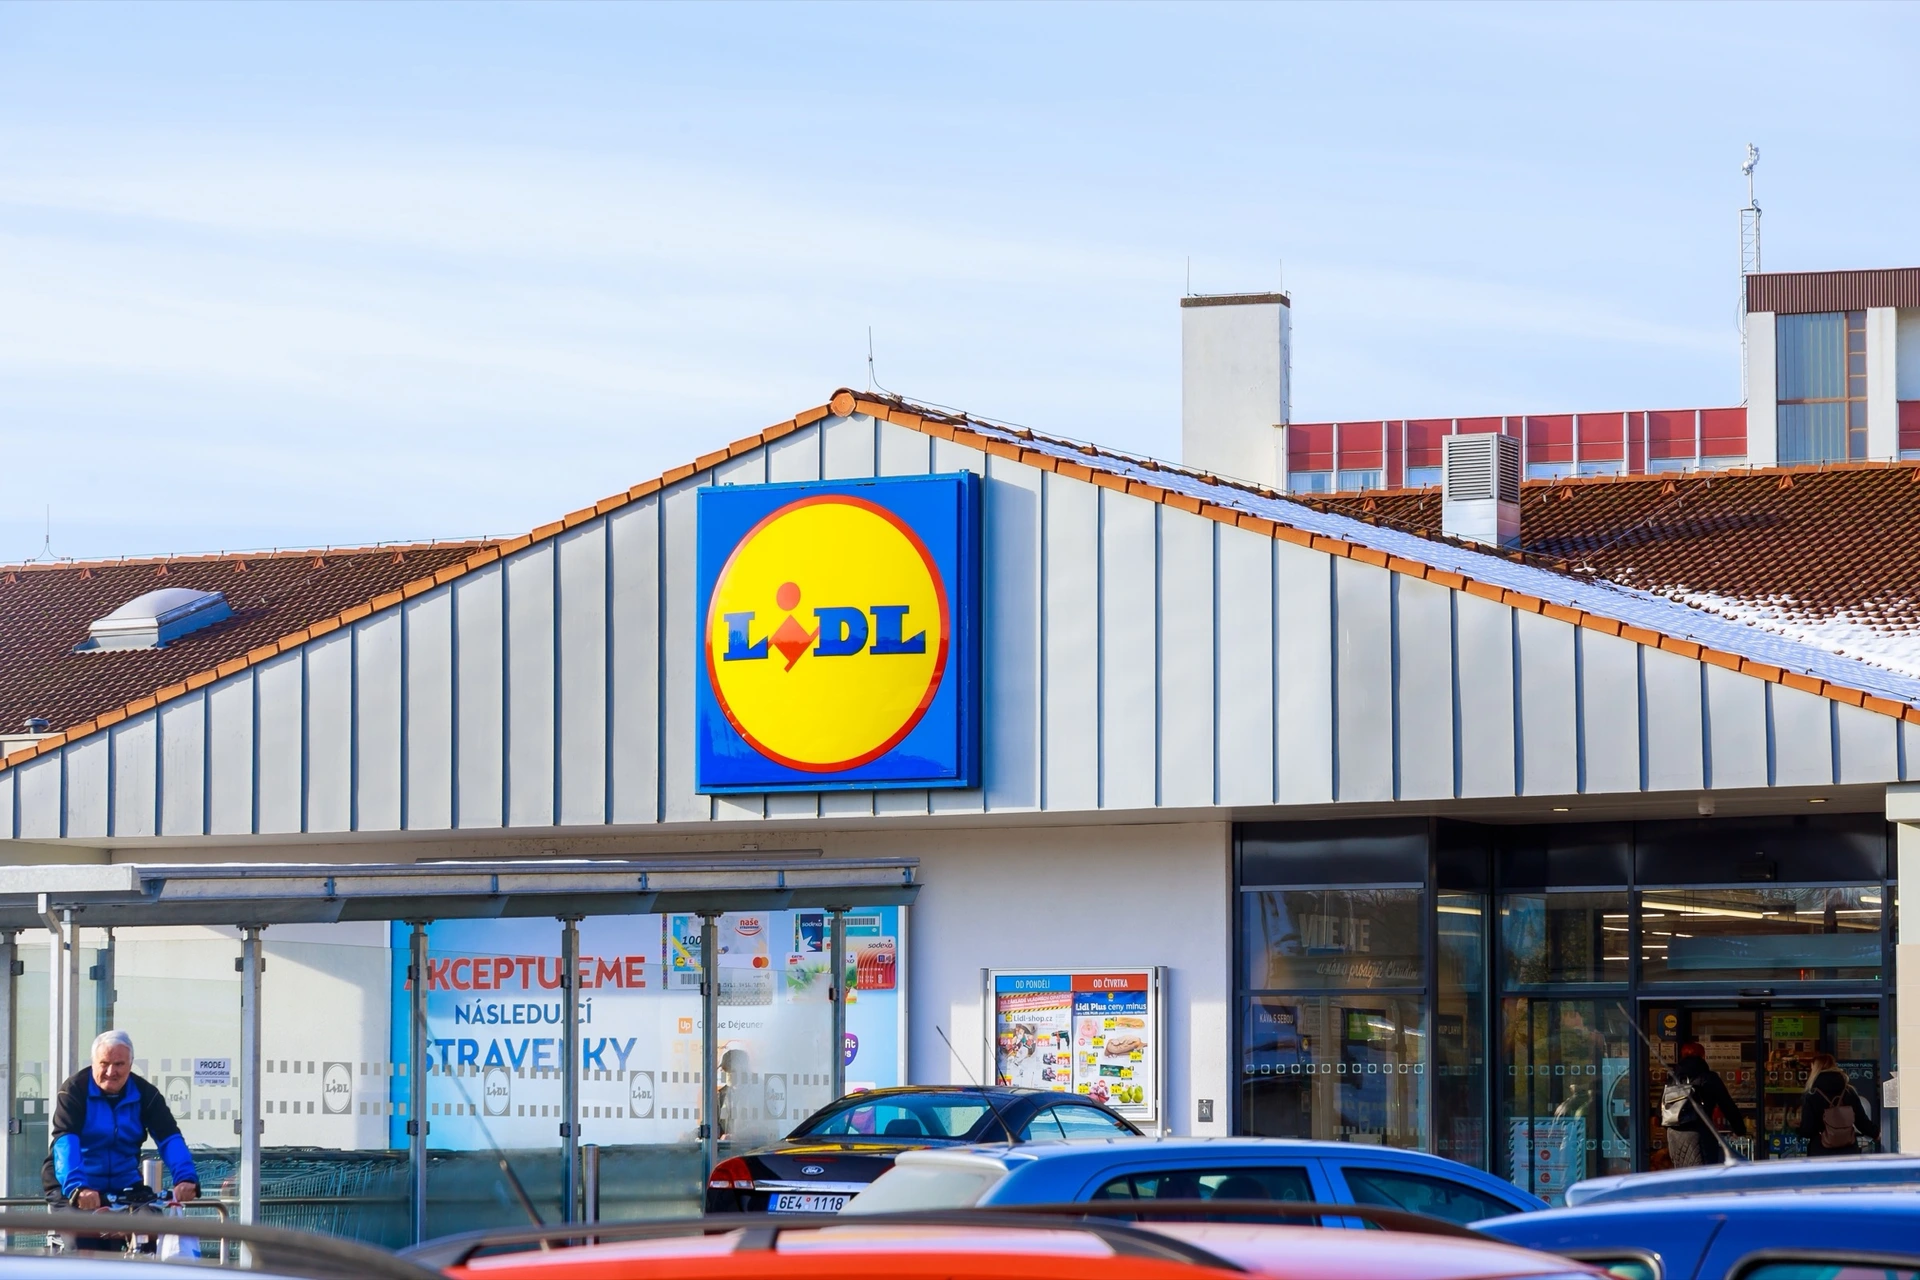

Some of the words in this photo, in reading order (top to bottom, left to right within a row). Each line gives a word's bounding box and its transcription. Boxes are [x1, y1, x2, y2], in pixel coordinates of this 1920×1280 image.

[740, 917, 759, 926] naše
[801, 919, 822, 928] sodexo
[682, 935, 702, 945] 100
[868, 939, 893, 949] sodexo
[404, 956, 646, 991] KCEPTUEME
[1015, 979, 1025, 989] OD
[1093, 979, 1102, 989] OD
[1103, 977, 1128, 988] ČTVRTKA
[455, 997, 592, 1025] NÁSLEDUCÍ
[1075, 1003, 1090, 1011] Lidl
[1090, 1002, 1106, 1010] Plus
[1125, 1002, 1147, 1010] minus
[1013, 1014, 1053, 1023] Lidl-shop.cz
[680, 1020, 691, 1031] Up
[728, 1019, 764, 1031] Déjeuner
[200, 1061, 226, 1069] PRODEJ
[779, 1196, 802, 1210] 6E4
[813, 1197, 844, 1211] 1118
